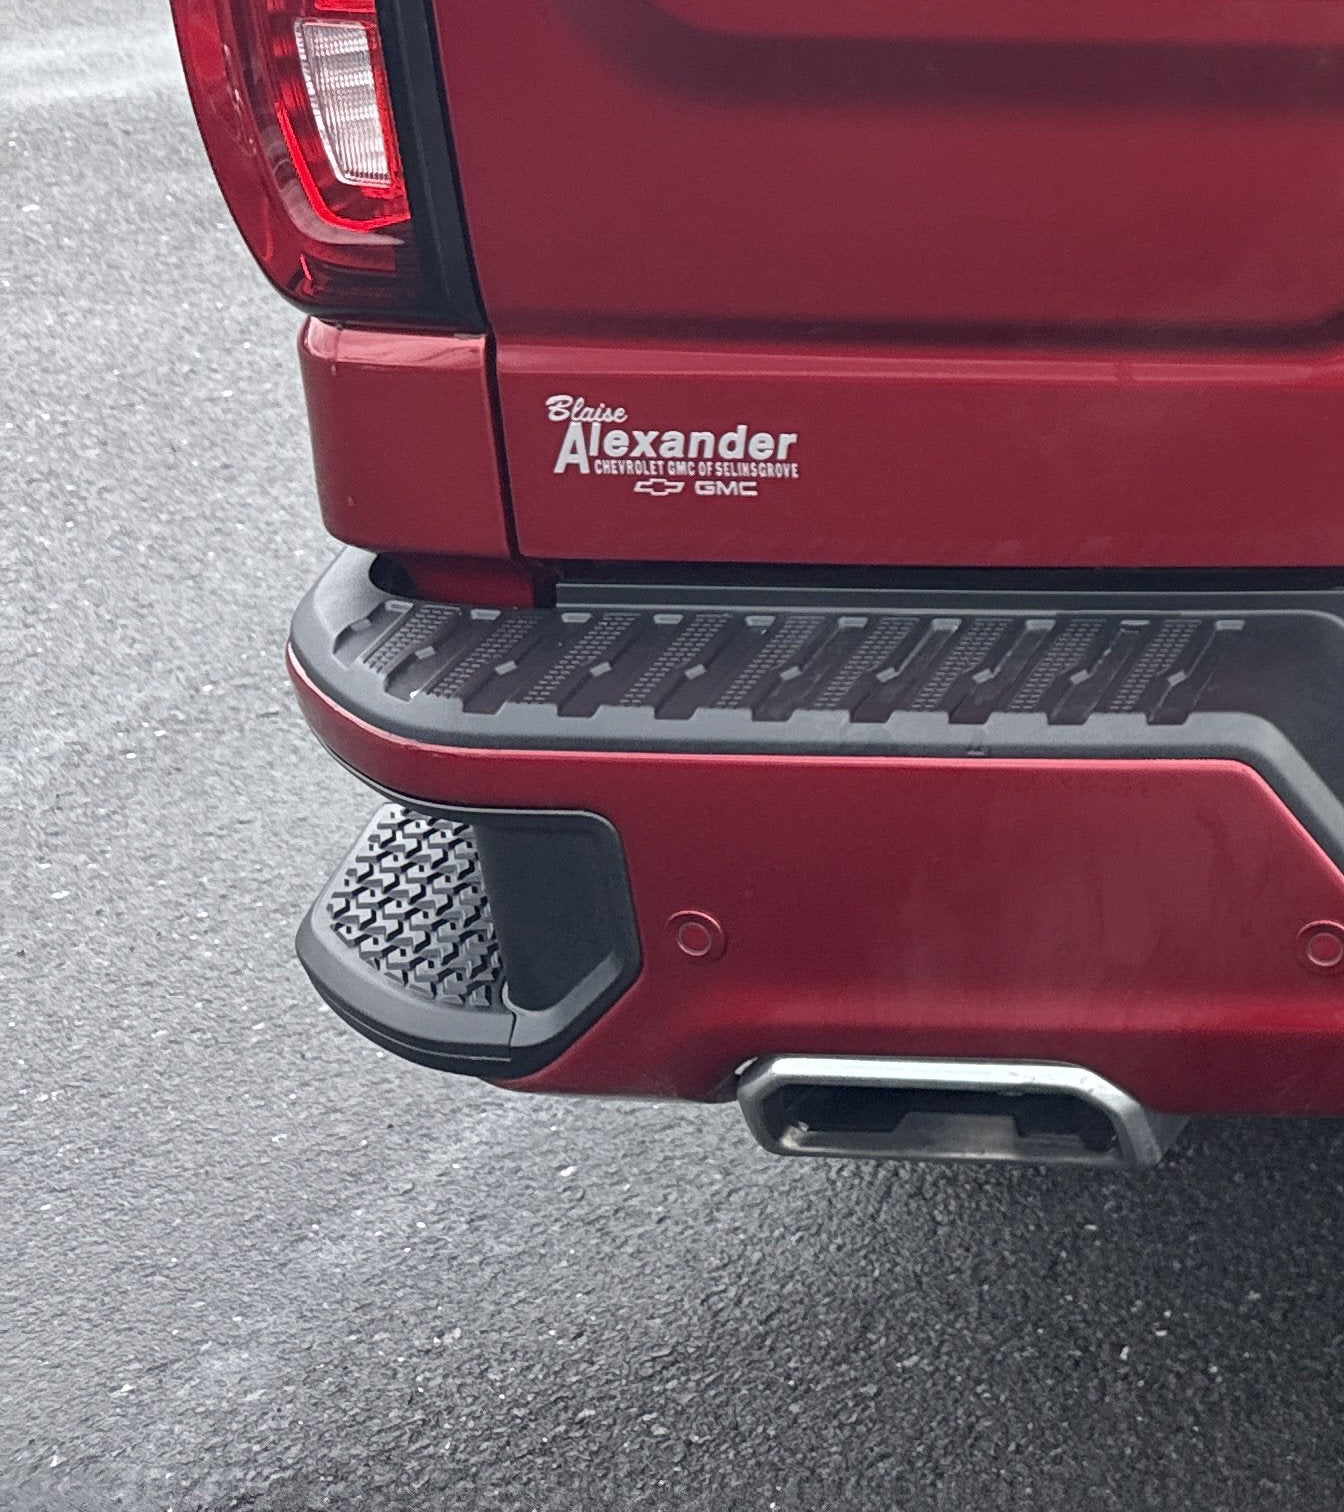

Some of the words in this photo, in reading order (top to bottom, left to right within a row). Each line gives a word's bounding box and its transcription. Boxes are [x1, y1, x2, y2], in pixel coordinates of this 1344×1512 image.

[545, 394, 628, 424] Blaise
[553, 421, 798, 475] Alexander
[594, 459, 665, 477] CHEVROLET
[667, 461, 696, 477] GMC
[698, 462, 714, 477] OF
[715, 462, 800, 479] SELINSGROVE
[693, 480, 759, 497] GMC
